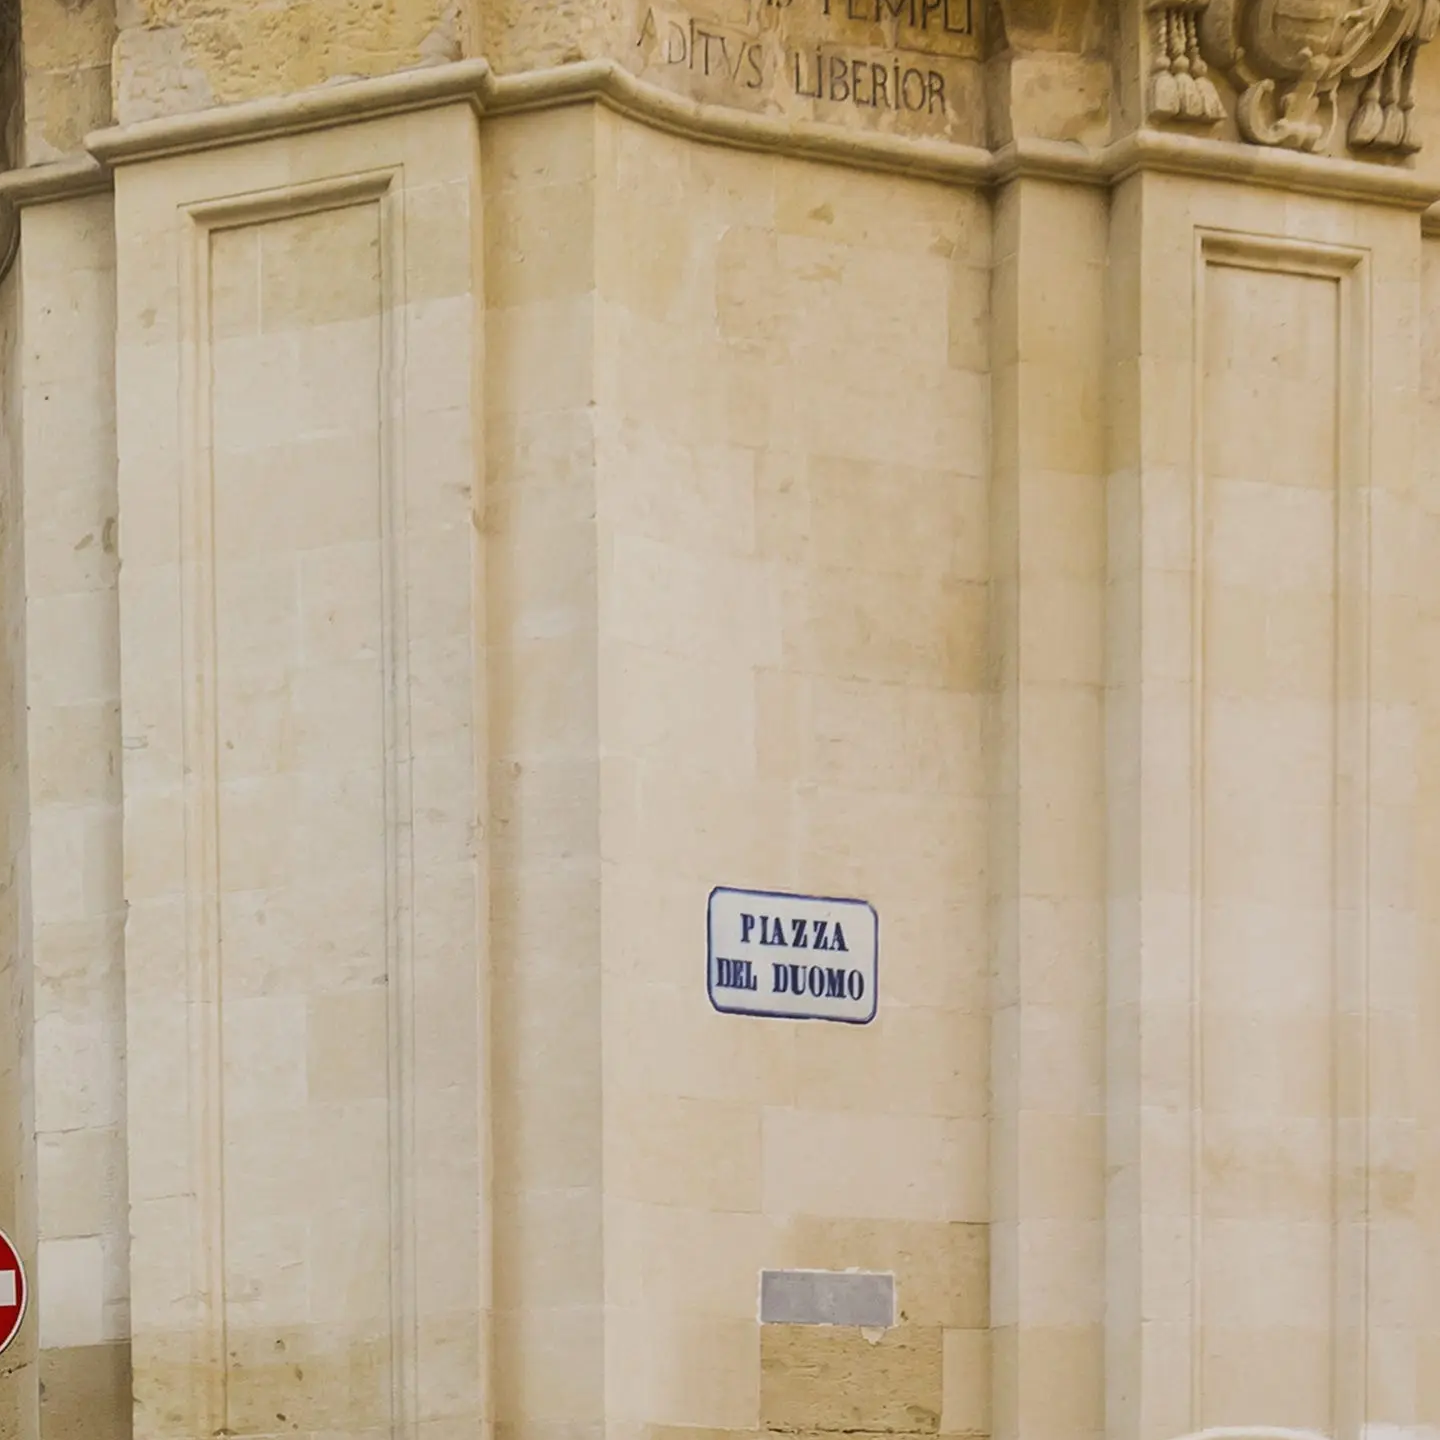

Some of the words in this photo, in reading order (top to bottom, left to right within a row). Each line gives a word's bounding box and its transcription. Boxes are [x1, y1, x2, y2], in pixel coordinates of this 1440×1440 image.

[793, 44, 948, 116] LIBERIOR
[740, 912, 849, 952] PIAZZA
[716, 957, 758, 991] DEL
[772, 962, 865, 1001] DUOMO
